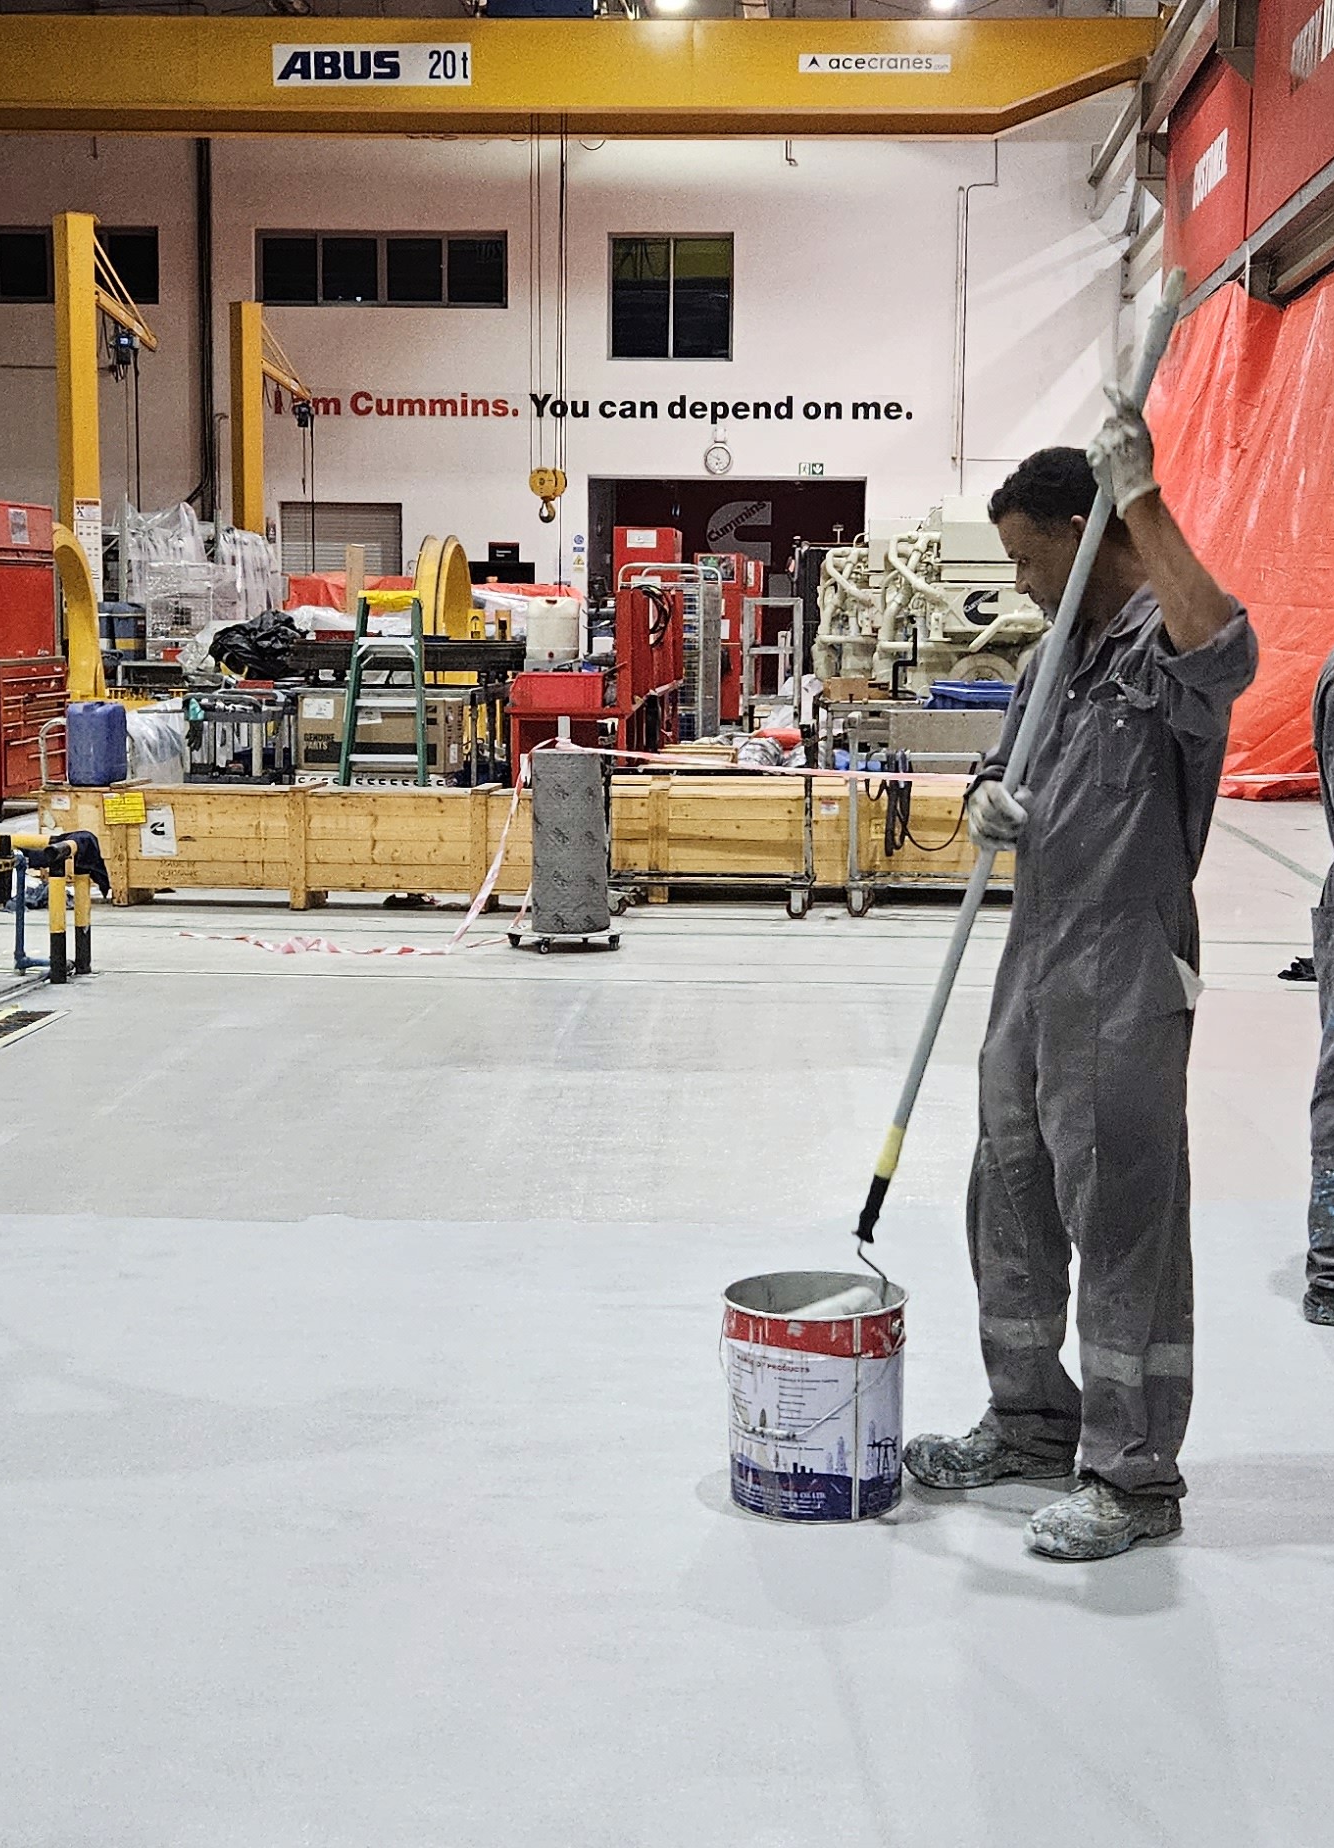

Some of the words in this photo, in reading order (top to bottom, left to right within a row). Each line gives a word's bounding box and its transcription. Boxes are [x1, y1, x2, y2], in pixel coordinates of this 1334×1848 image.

[277, 50, 401, 80] ABUS
[429, 50, 456, 79] 20
[461, 51, 469, 79] t
[349, 391, 518, 417] Cummins.
[530, 393, 589, 418] You
[599, 399, 658, 419] can
[667, 395, 794, 424] depend
[803, 400, 843, 420] on
[851, 400, 914, 420] me.
[708, 501, 767, 542] Cummins
